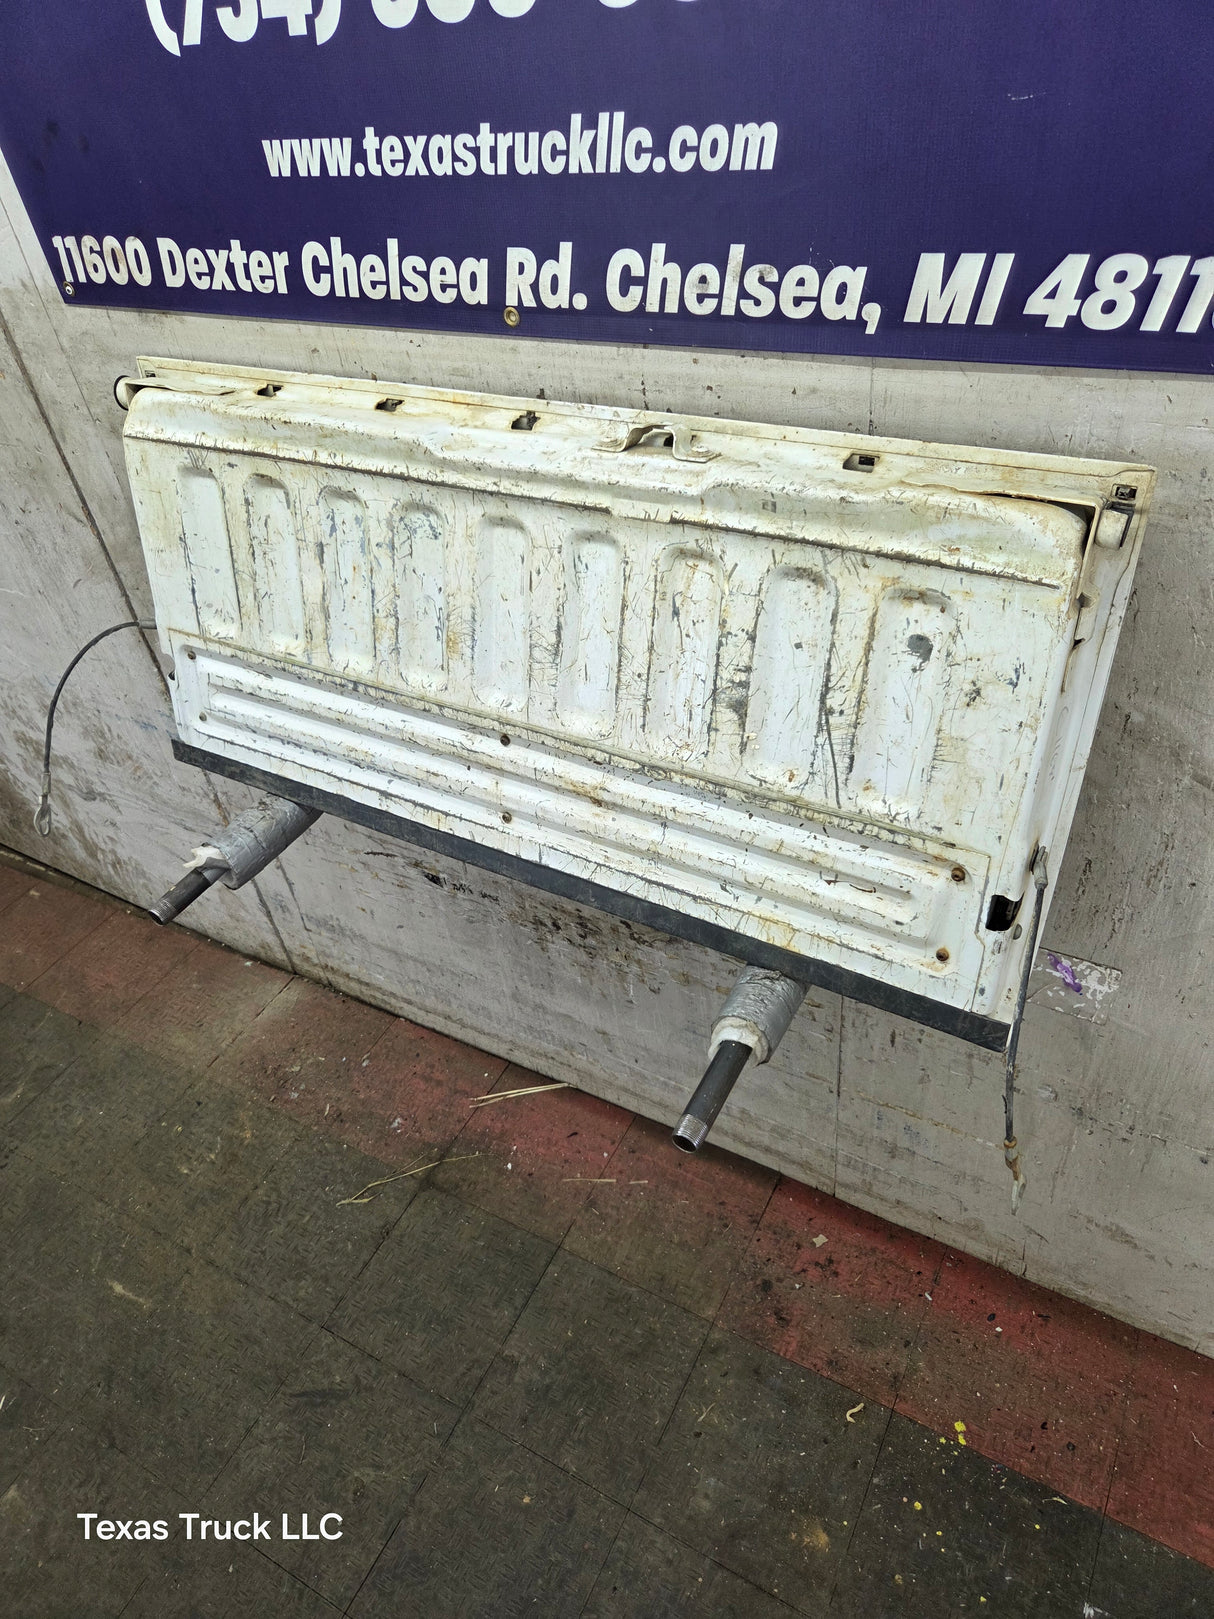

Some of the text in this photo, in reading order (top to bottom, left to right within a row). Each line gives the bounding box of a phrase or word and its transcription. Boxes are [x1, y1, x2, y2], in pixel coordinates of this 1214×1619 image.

[261, 110, 779, 178] www.texastruckllc.com
[51, 234, 1214, 335] 11600 Dexter Chelsea Rd. Chelsea, MI 4811
